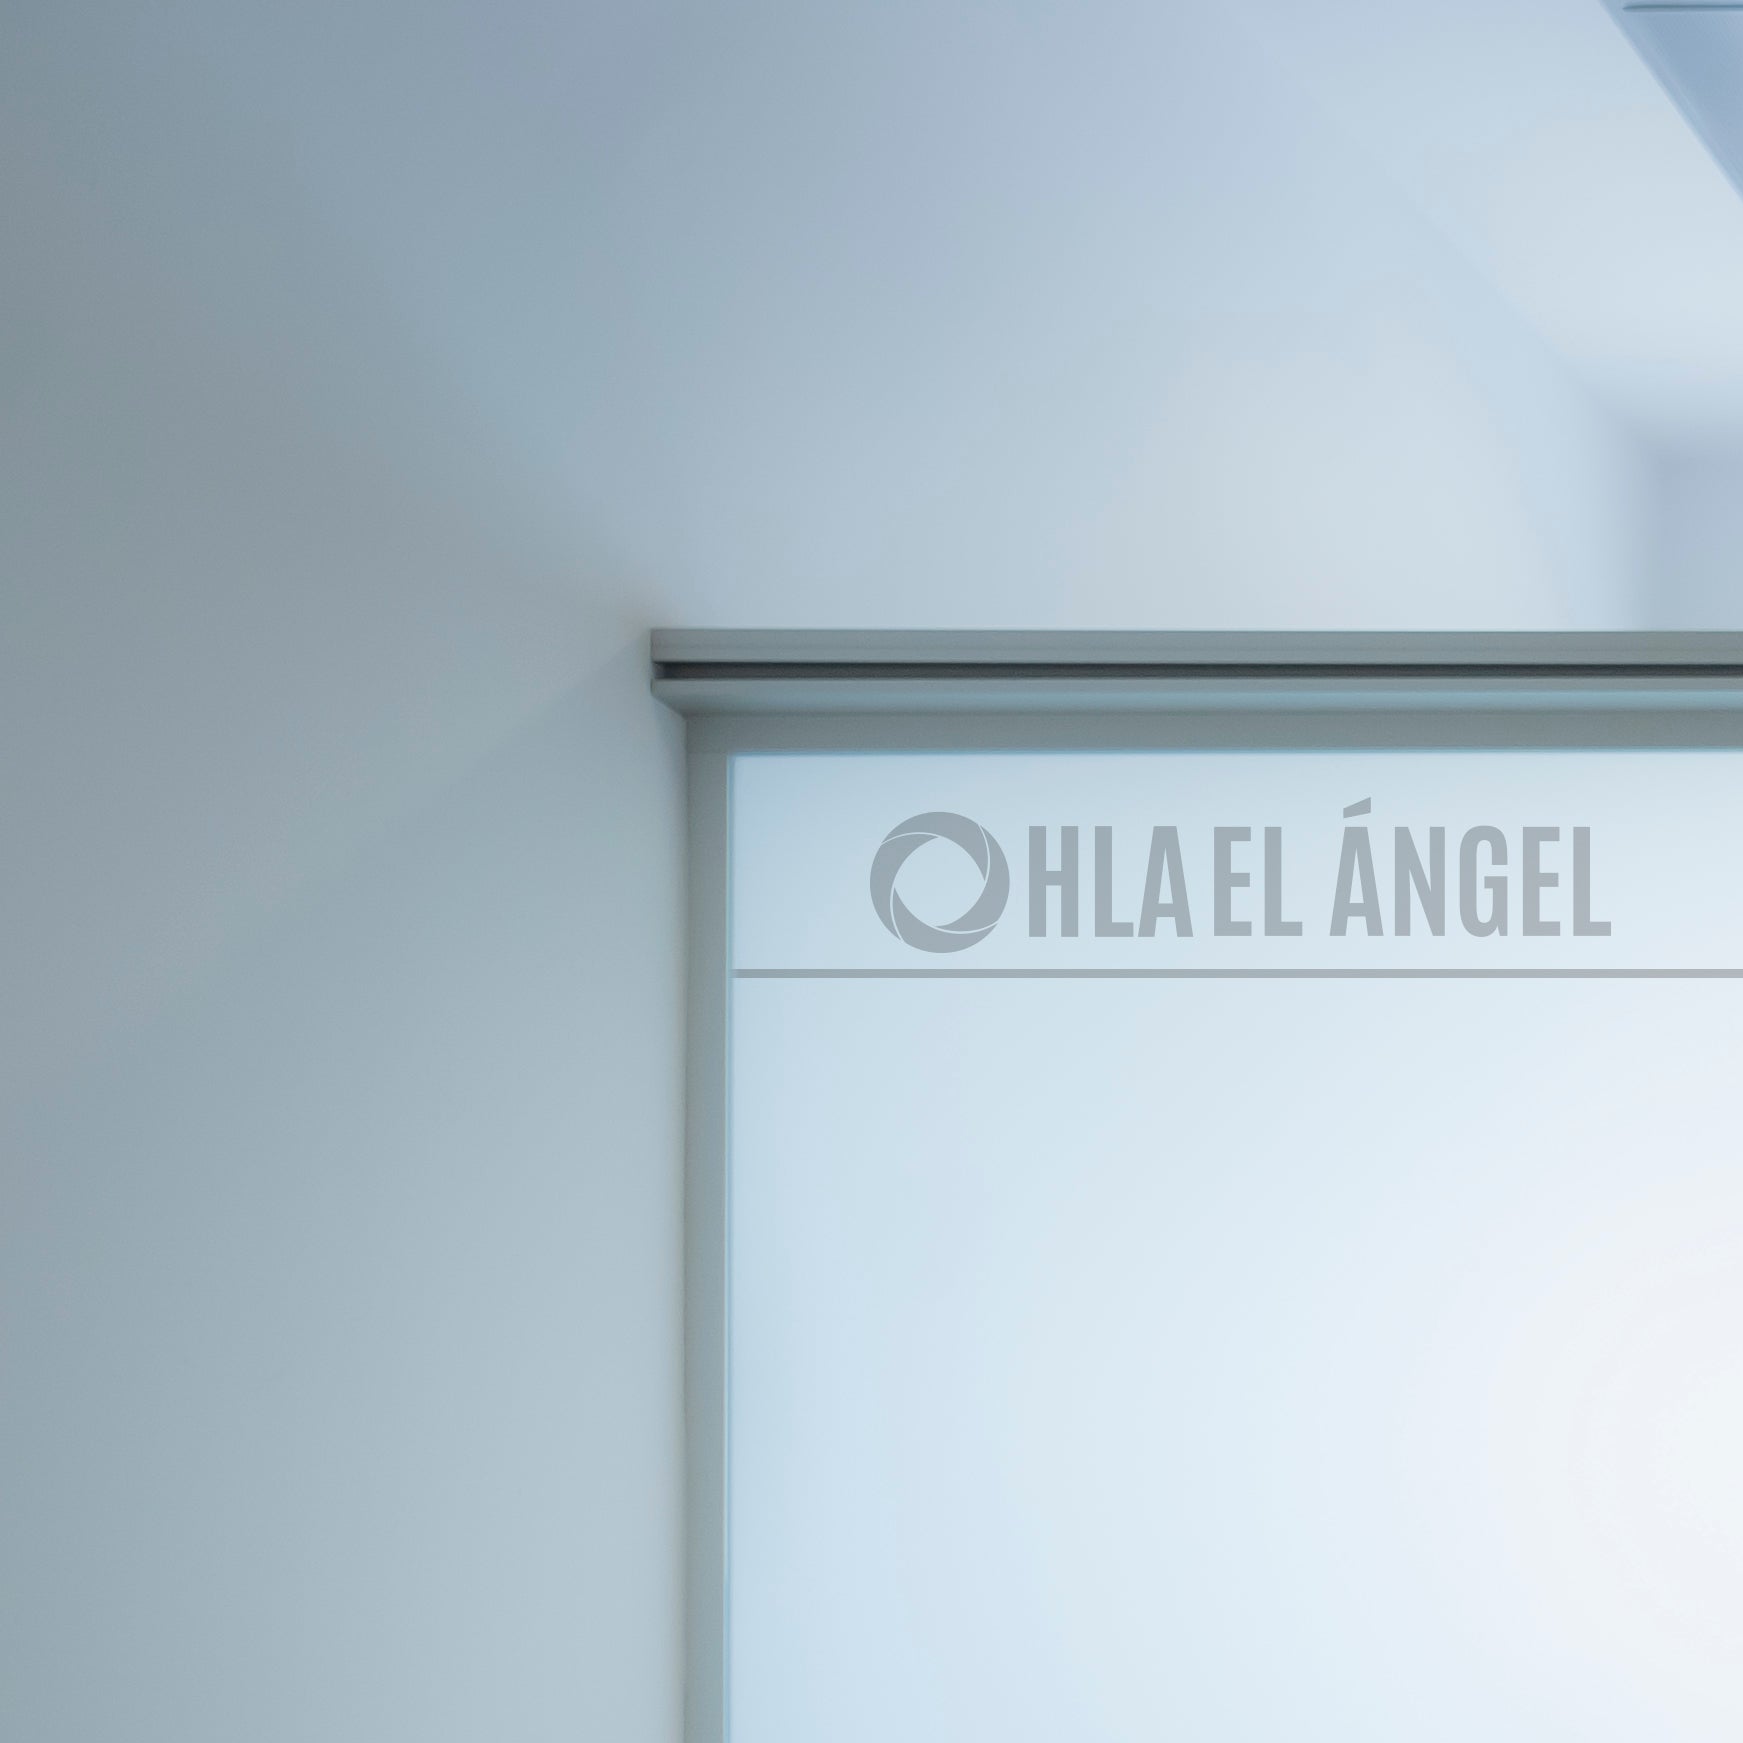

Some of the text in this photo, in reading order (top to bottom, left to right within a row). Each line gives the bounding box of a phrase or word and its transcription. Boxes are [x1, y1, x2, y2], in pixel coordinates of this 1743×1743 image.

[1028, 796, 1612, 938] HLA EL ÁNGEL
